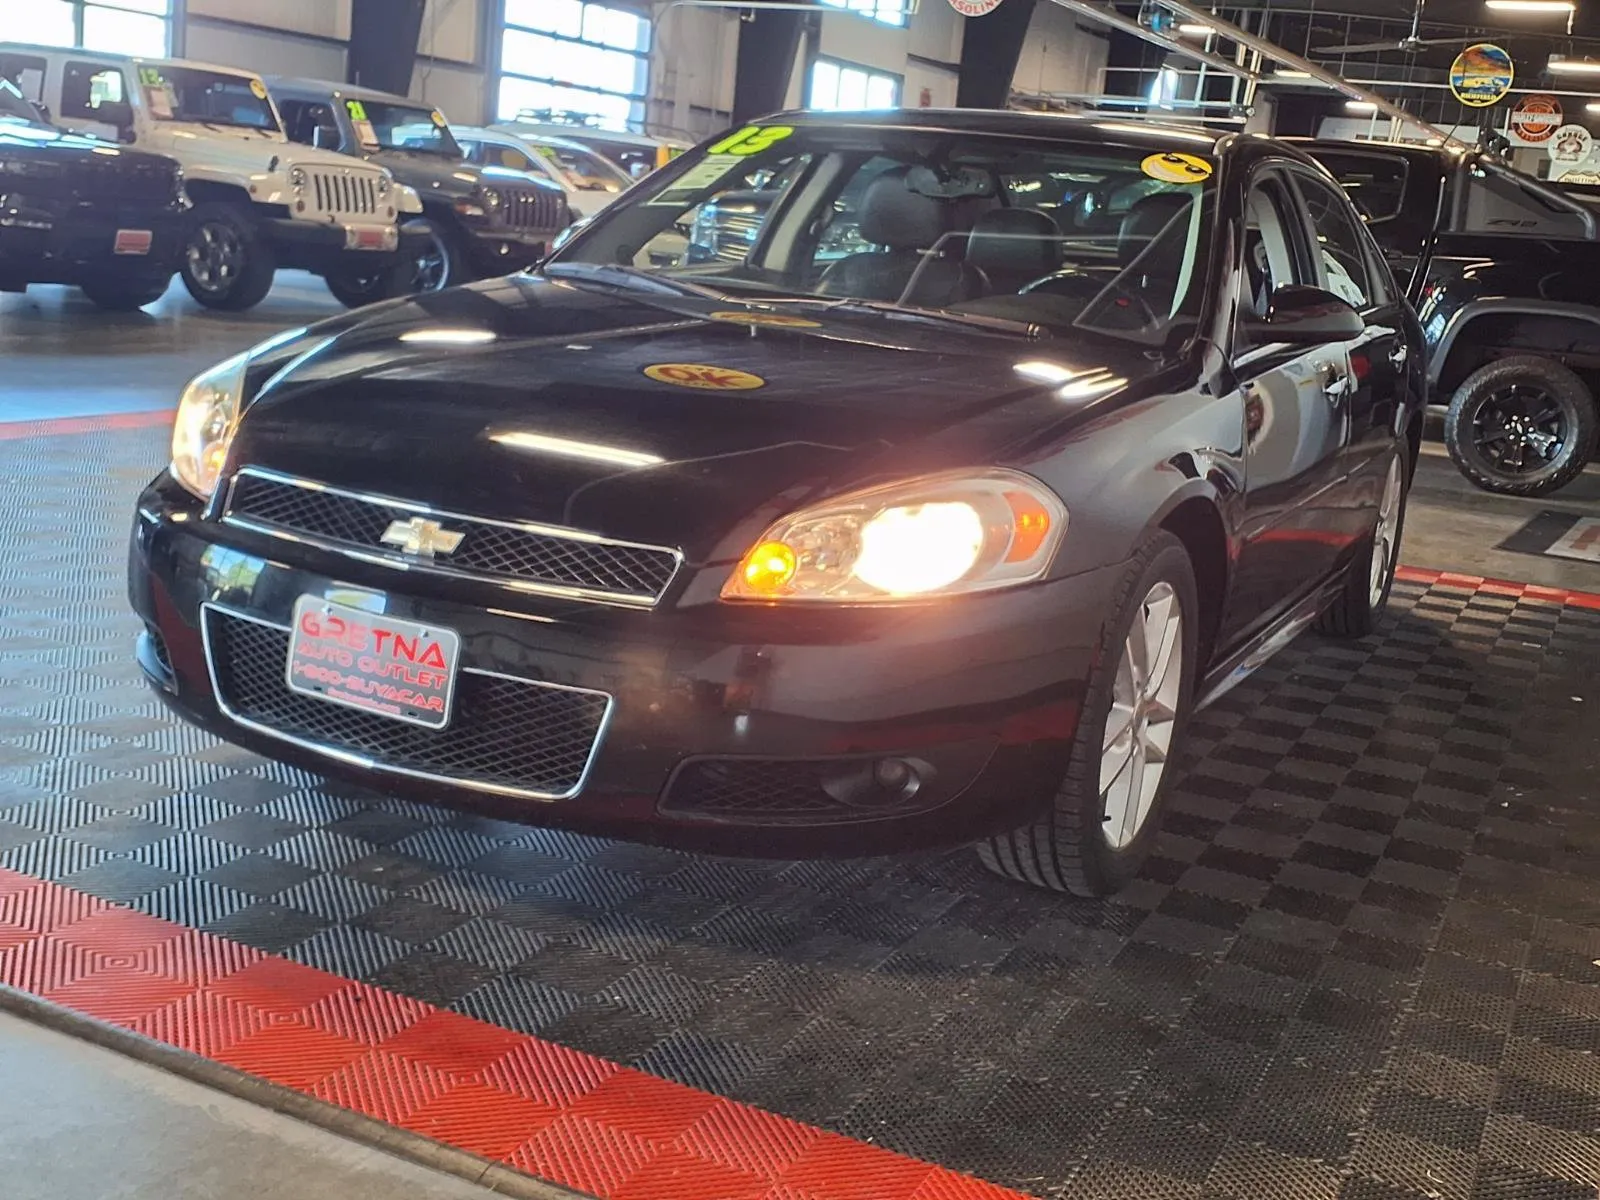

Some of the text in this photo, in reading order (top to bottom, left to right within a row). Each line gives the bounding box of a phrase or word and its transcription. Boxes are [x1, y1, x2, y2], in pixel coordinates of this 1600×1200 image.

[707, 126, 796, 156] 13
[297, 641, 448, 690] AUTO OUTLET
[302, 611, 446, 669] GRETNA
[293, 660, 444, 713] 1-800-BUYACAR
